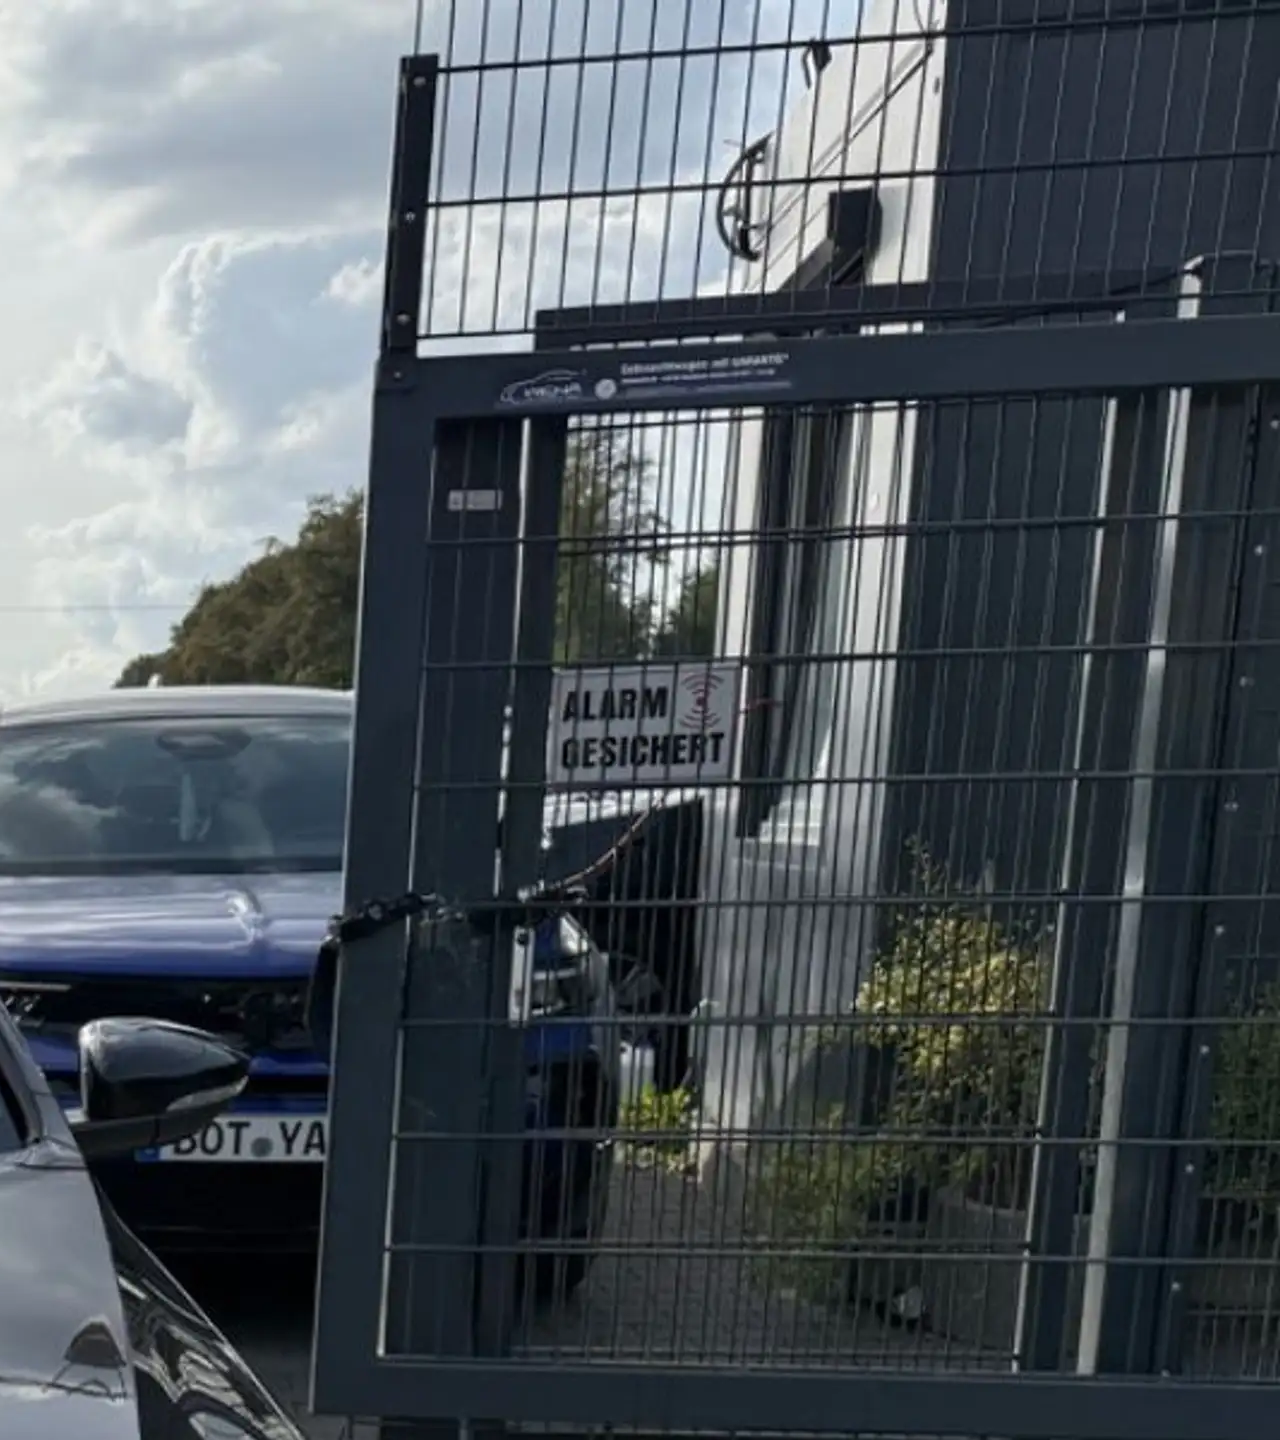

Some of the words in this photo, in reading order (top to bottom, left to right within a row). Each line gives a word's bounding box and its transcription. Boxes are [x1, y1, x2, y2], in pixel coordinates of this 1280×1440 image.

[562, 686, 668, 722] ALARM
[561, 731, 725, 770] GESICHERT
[278, 1120, 326, 1156] YA
